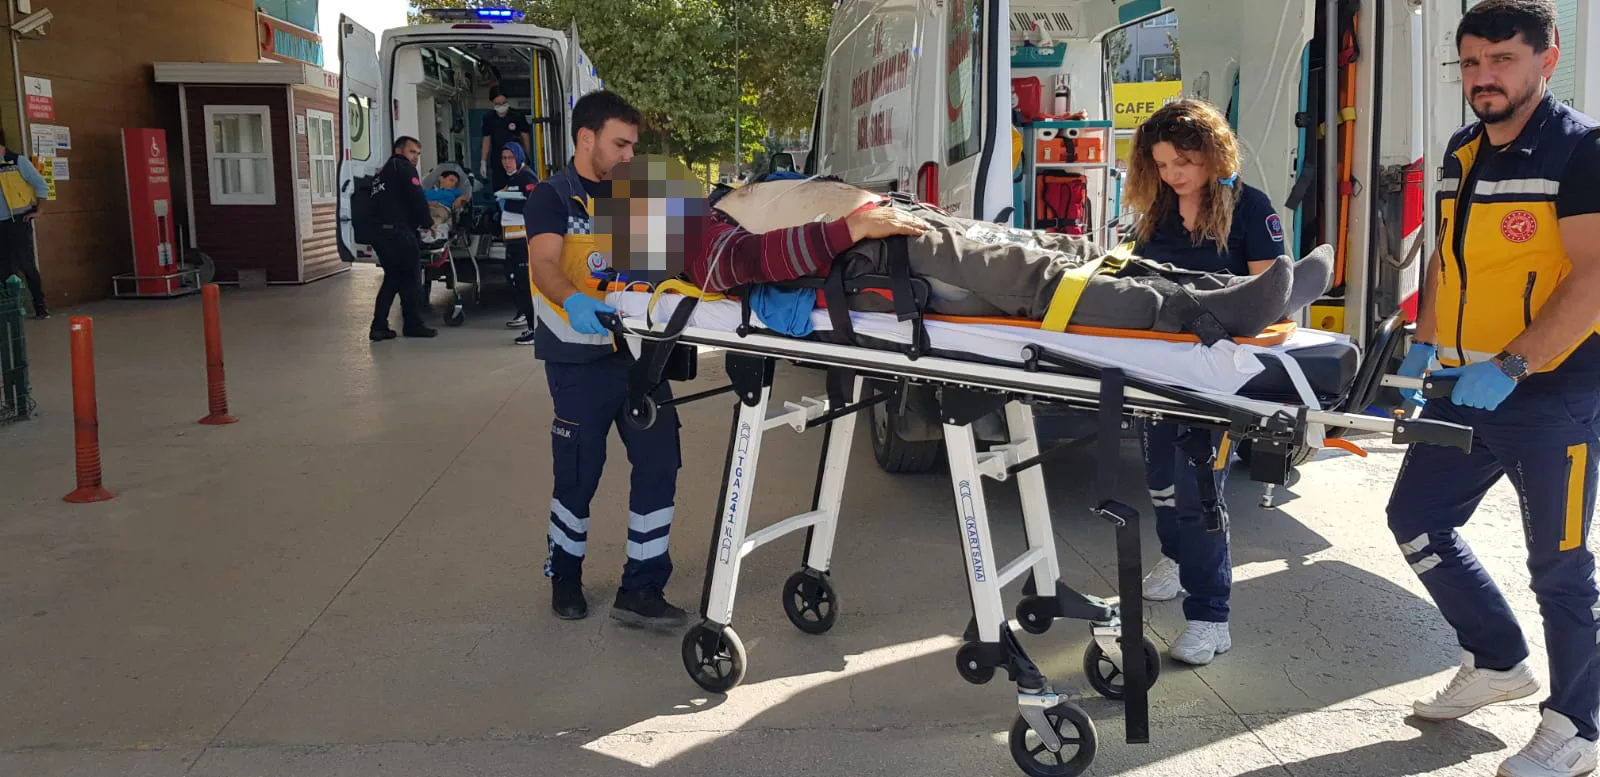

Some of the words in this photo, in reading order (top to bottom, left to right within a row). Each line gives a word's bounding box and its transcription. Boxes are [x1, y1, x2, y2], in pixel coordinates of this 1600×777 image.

[1114, 101, 1155, 114] CAFE
[732, 455, 745, 488] TGA
[728, 491, 740, 525] 241
[967, 522, 984, 580] KARTSANA
